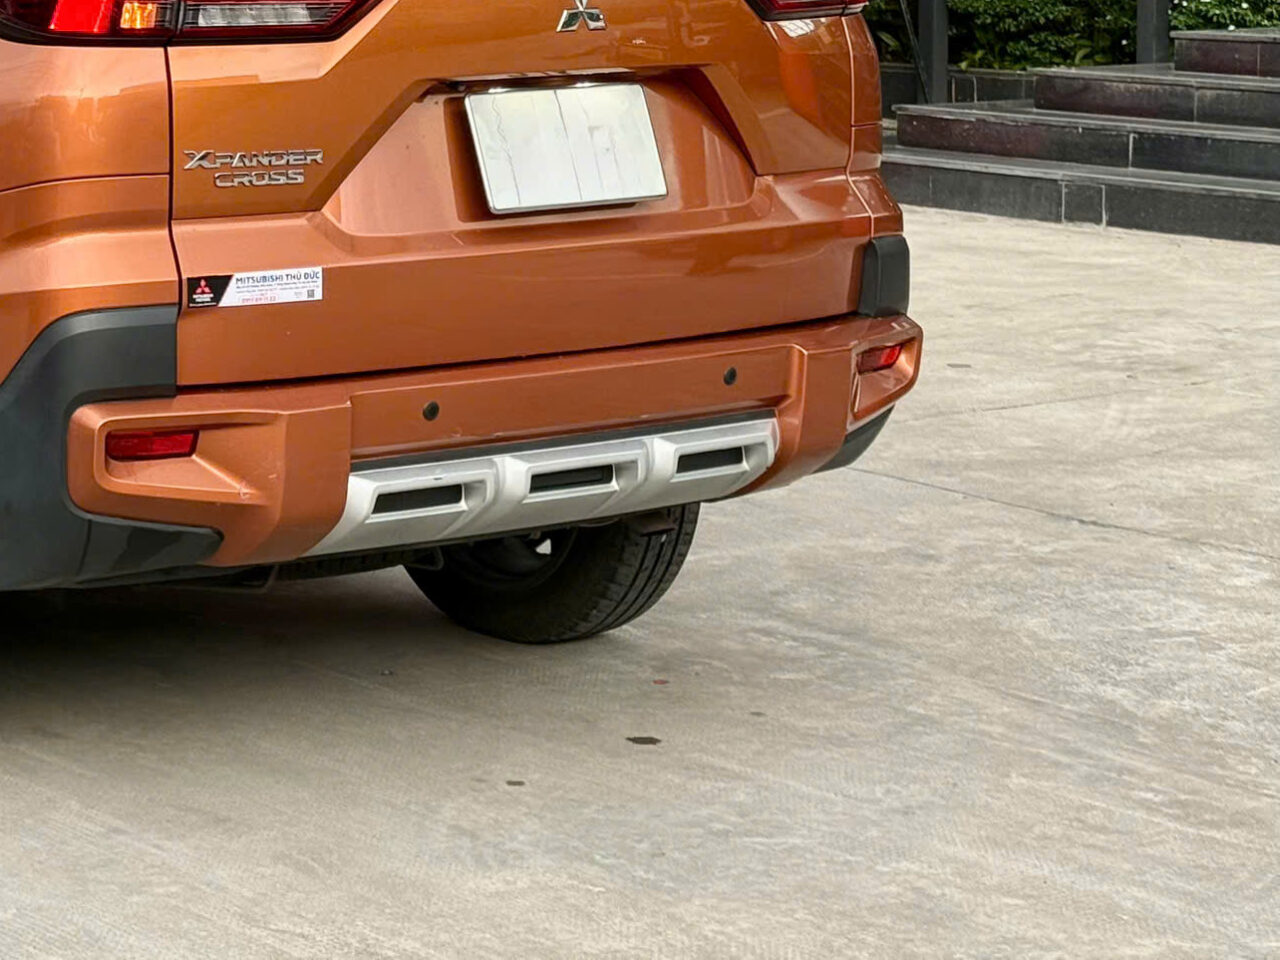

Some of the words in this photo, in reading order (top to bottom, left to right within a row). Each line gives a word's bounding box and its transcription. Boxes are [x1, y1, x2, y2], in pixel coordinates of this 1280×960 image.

[184, 149, 323, 169] XPANDER
[215, 169, 304, 187] CROSS
[235, 274, 284, 285] MITSUBISHI
[303, 269, 320, 280] ĐỨC
